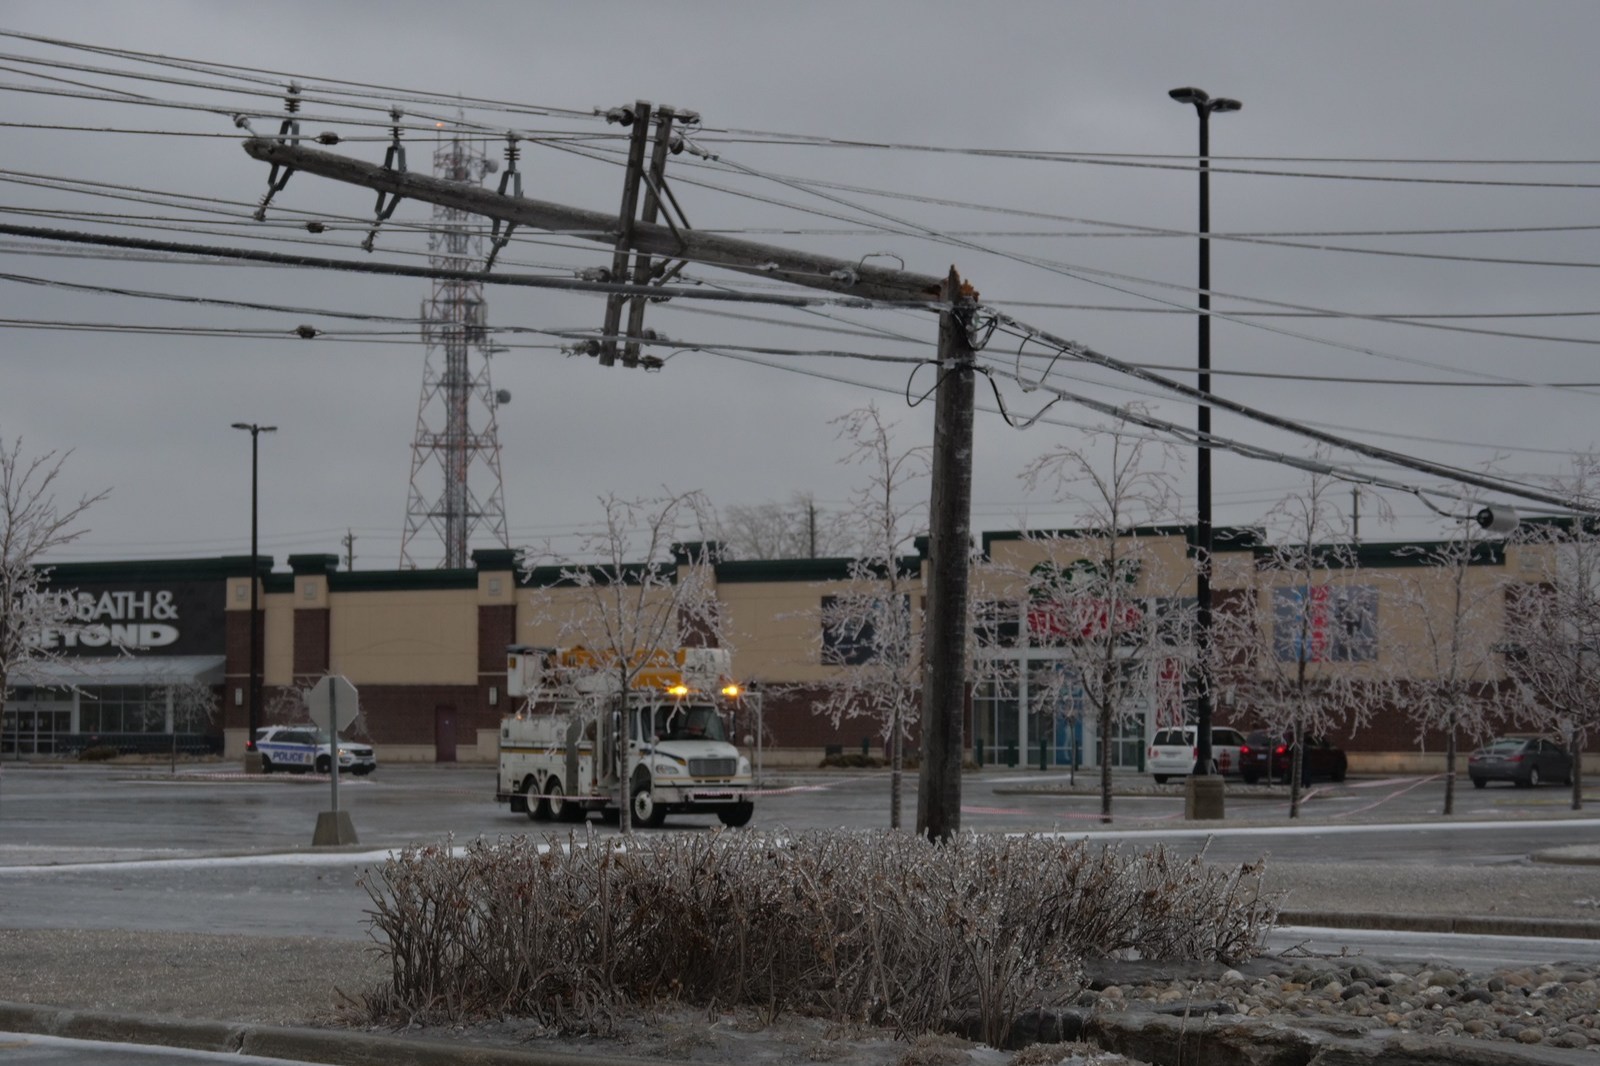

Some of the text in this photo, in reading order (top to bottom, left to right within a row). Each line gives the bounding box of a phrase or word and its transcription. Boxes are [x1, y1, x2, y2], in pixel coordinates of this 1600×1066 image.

[77, 590, 152, 620] BATH
[153, 590, 179, 620] &
[272, 751, 304, 762] POLICE
